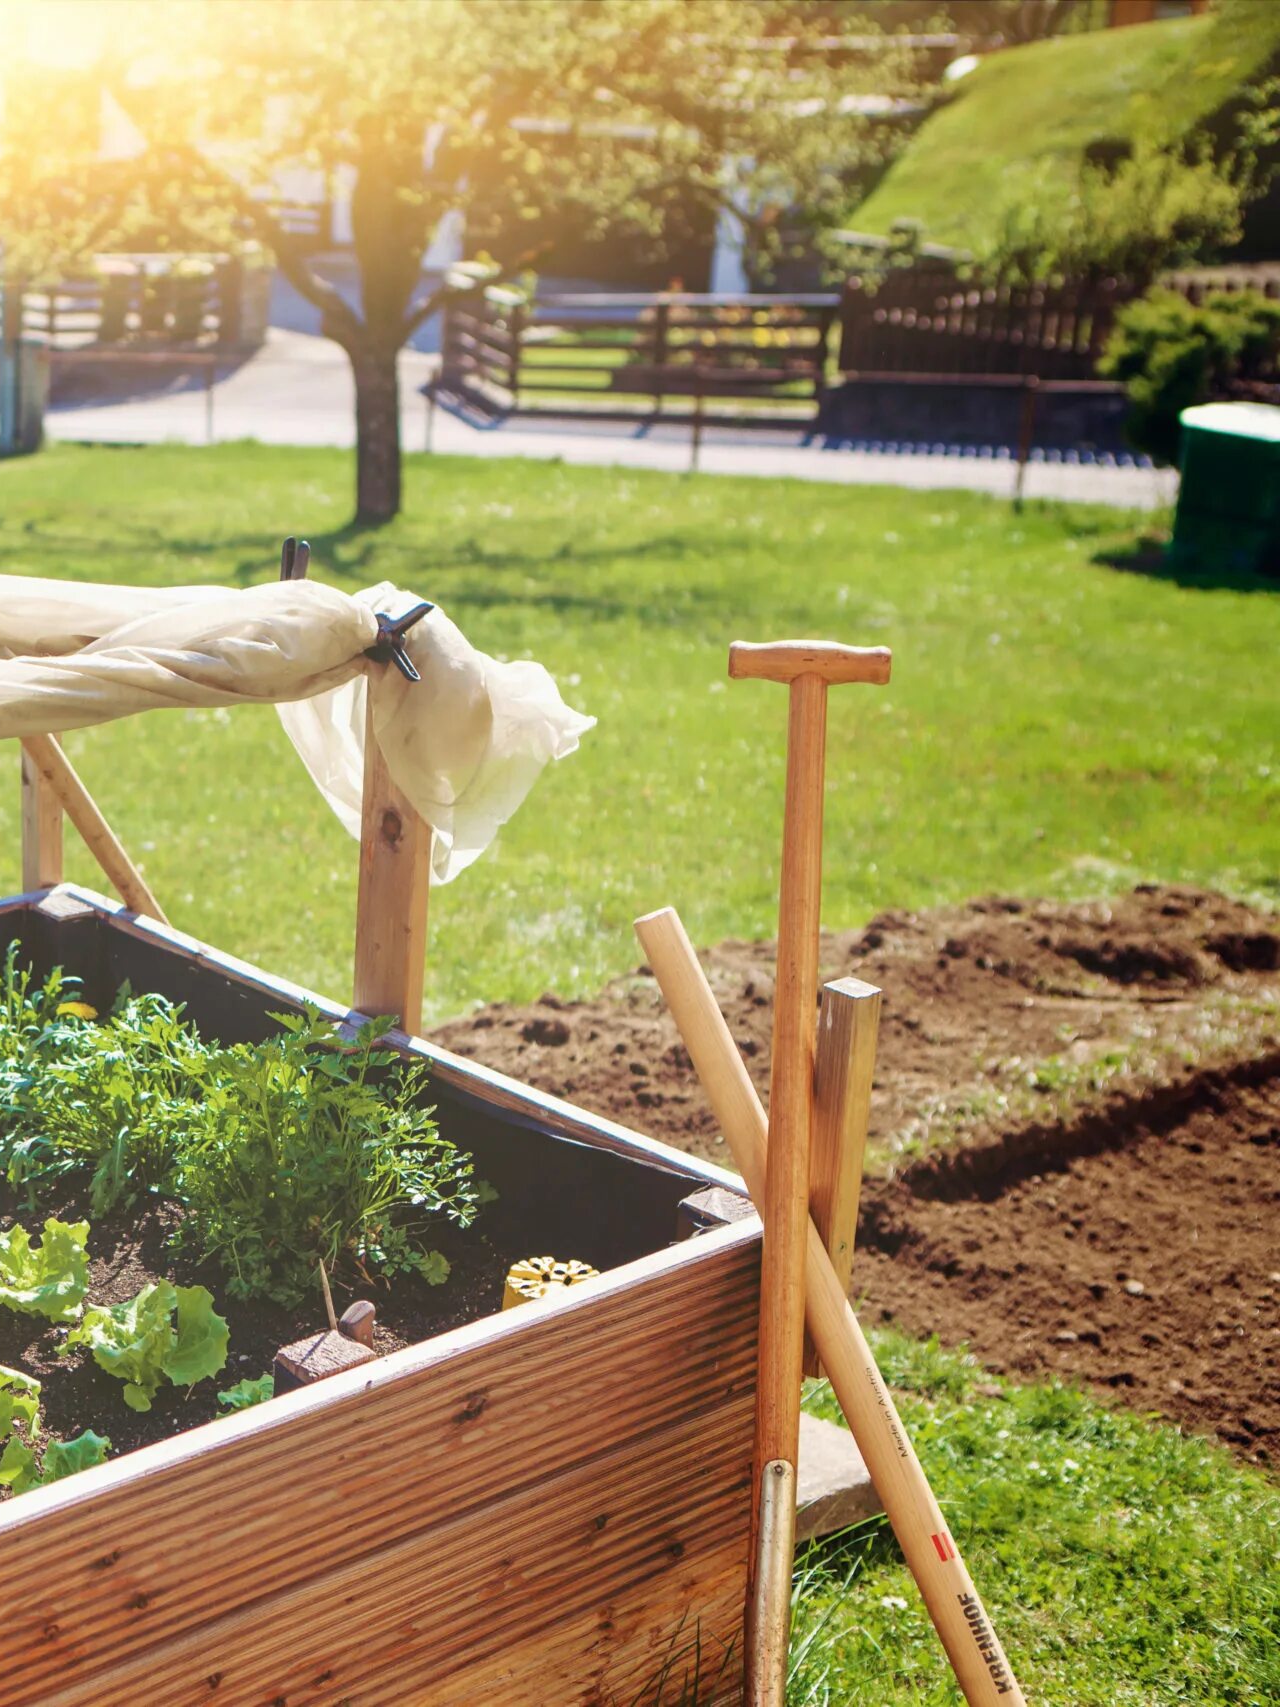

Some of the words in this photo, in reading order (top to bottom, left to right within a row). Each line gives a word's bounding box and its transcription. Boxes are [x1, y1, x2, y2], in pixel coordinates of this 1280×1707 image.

[866, 1367, 887, 1406] Austria
[884, 1410, 893, 1421] in
[891, 1424, 908, 1457] Made
[958, 1593, 1012, 1694] KRENHOF
